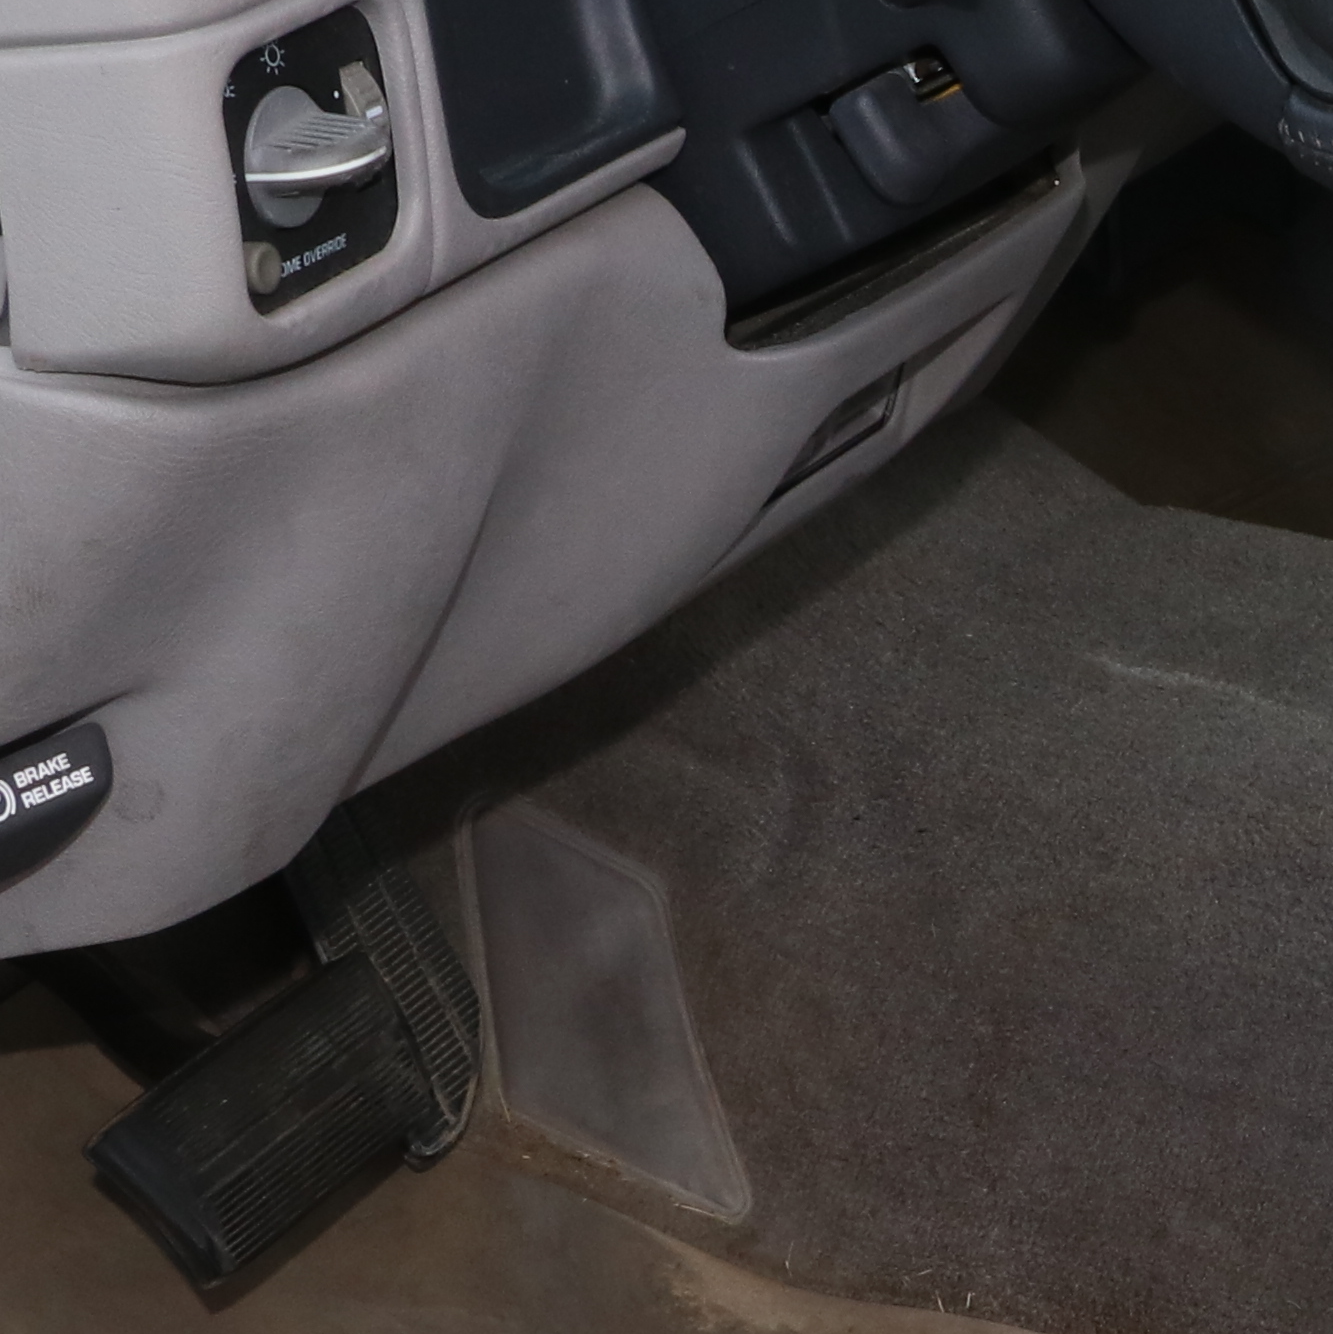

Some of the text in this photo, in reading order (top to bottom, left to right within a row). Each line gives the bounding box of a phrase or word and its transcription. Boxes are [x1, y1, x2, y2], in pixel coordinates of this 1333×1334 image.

[303, 232, 348, 267] OVERRIDE
[12, 752, 72, 789] BRAKE
[20, 766, 95, 809] RELEASE
